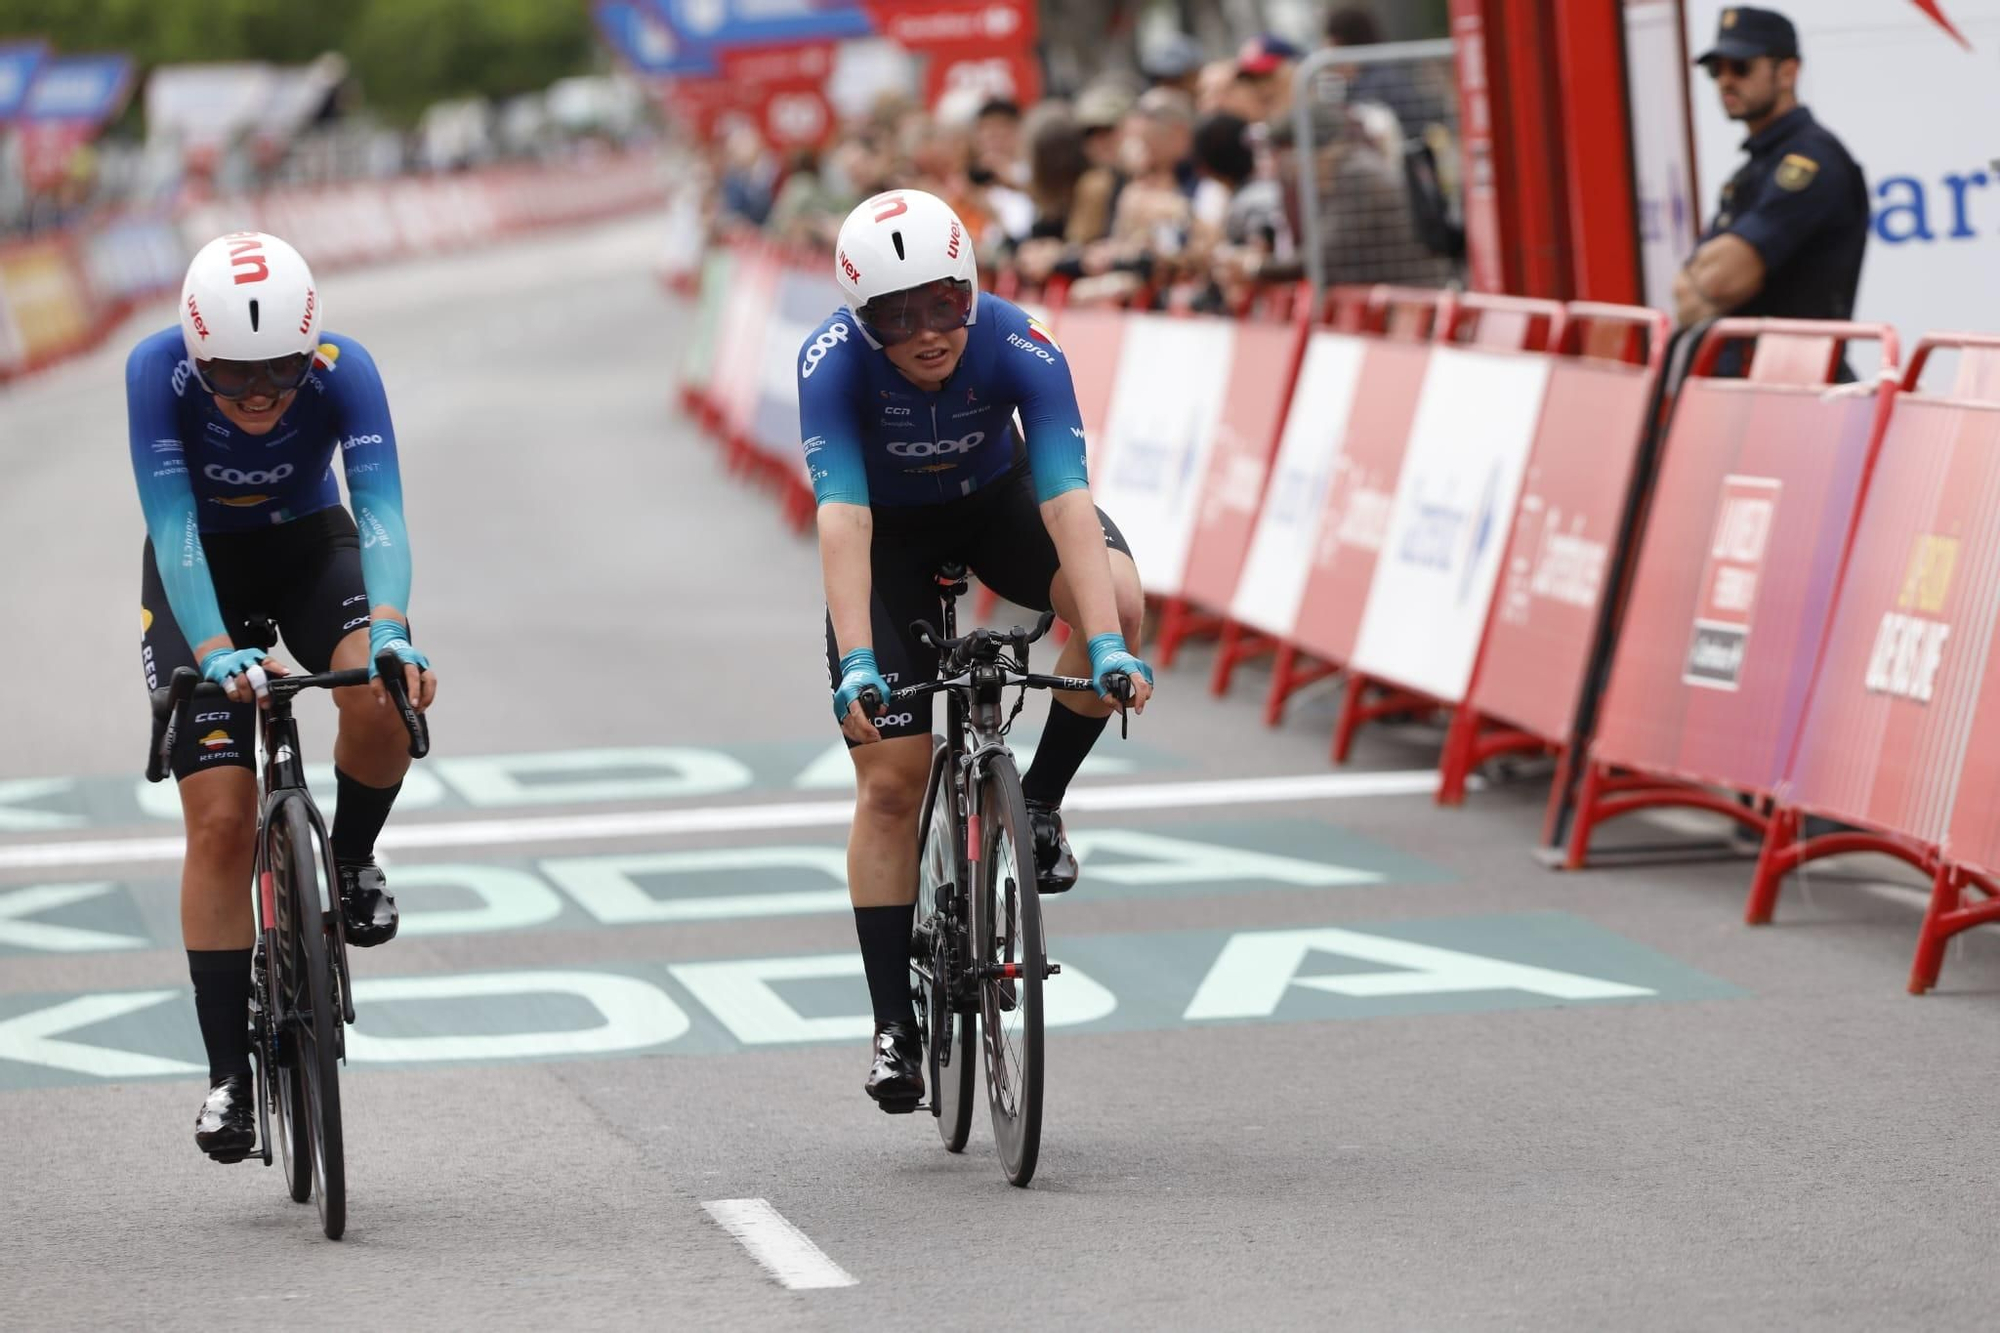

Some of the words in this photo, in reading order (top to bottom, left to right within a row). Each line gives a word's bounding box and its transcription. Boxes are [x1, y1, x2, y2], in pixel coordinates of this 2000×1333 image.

[947, 220, 960, 259] uvex
[838, 249, 861, 285] uvex
[187, 294, 210, 341] uvex
[299, 287, 315, 335] uvex
[802, 322, 849, 379] coop
[1006, 331, 1055, 365] REPSOL
[343, 433, 384, 450] ahoo
[886, 431, 985, 457] coop
[203, 463, 294, 485] coop
[142, 644, 158, 690] REP
[875, 711, 913, 728] oop
[199, 750, 240, 762] REPSOL
